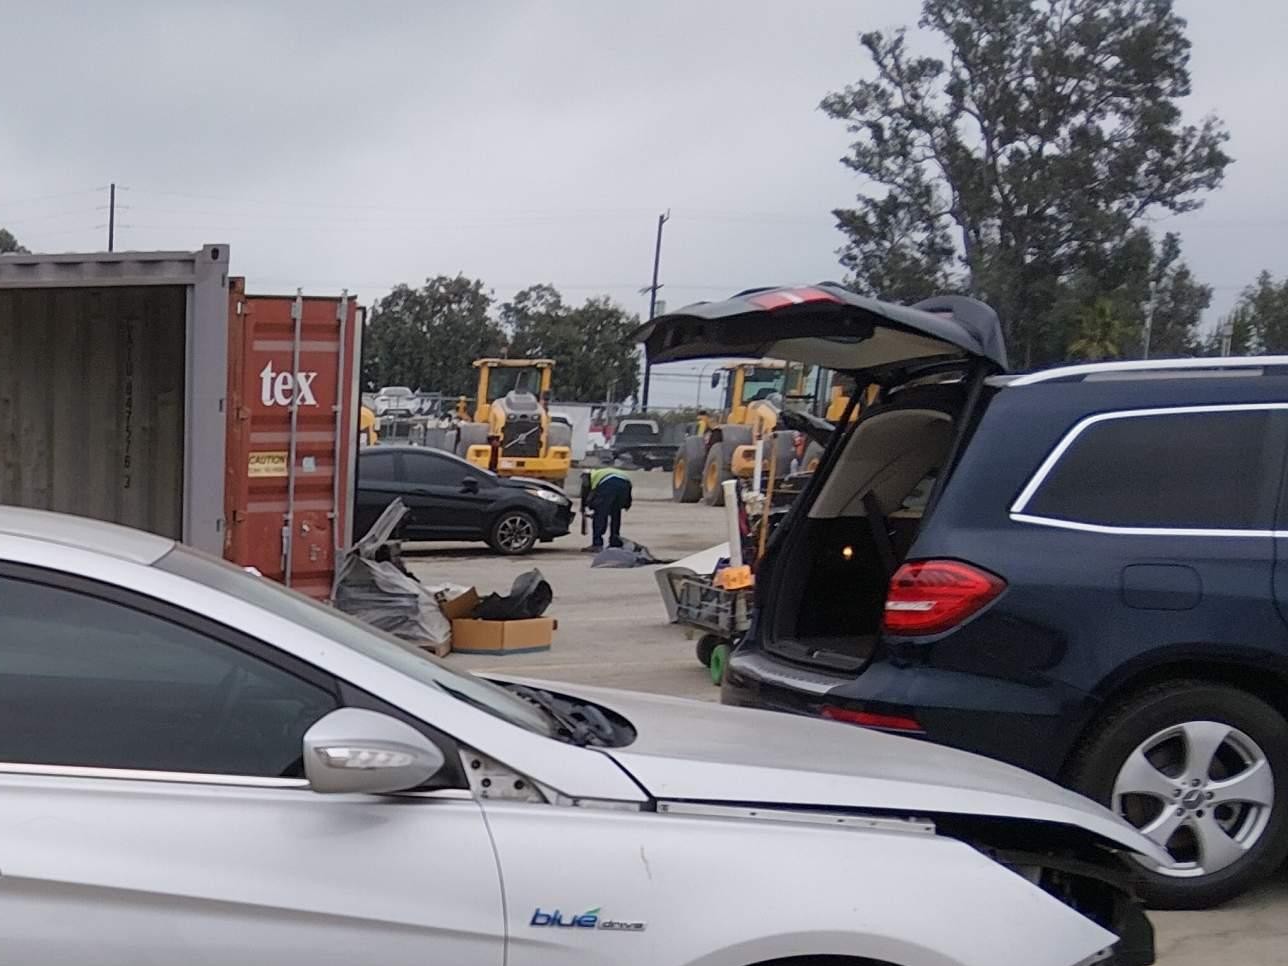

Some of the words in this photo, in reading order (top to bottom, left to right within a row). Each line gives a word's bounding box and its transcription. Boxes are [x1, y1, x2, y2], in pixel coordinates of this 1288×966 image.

[259, 360, 318, 407] tex
[249, 455, 285, 465] CAUTION
[601, 920, 645, 930] drive
